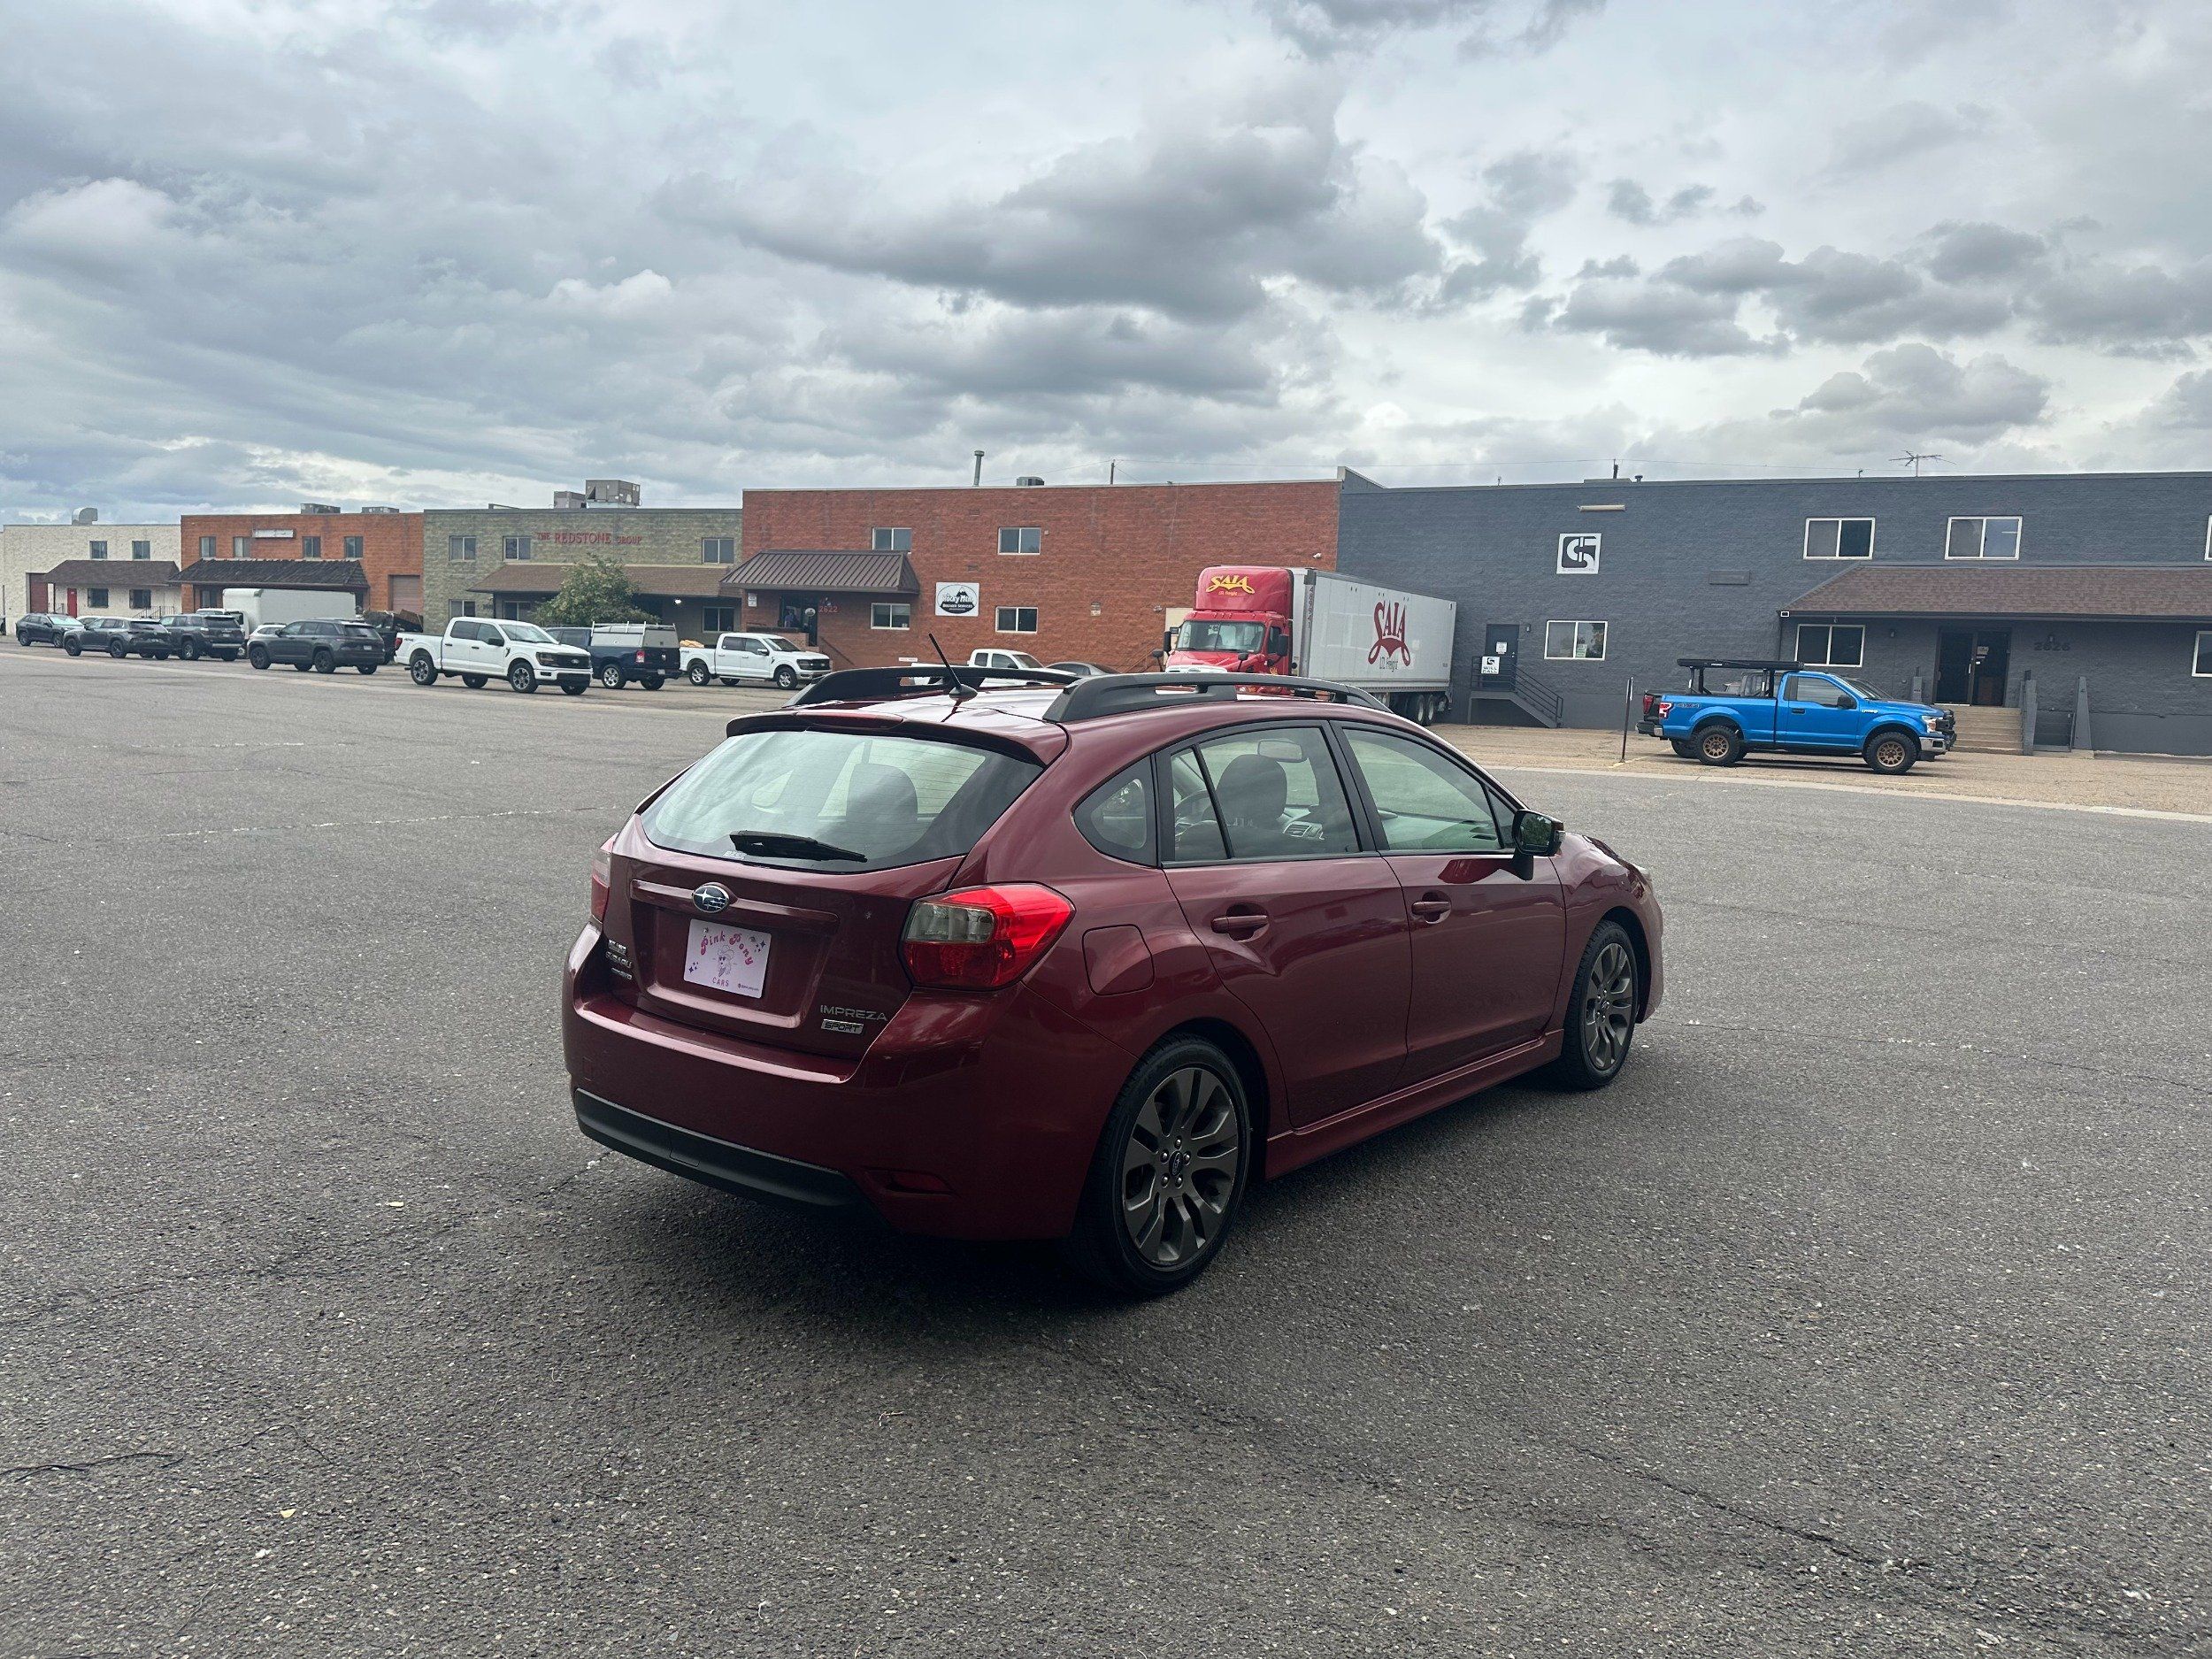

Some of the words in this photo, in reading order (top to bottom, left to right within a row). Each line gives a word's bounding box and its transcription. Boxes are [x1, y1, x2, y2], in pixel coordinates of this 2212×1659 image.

[554, 533, 611, 544] REDSTONE
[617, 535, 642, 544] GROUP
[1206, 575, 1255, 594] SAIA
[1368, 600, 1410, 667] SAIA
[712, 977, 729, 987] CARS
[820, 1004, 887, 1021] IMPREZA
[824, 1020, 860, 1032] SPORT
